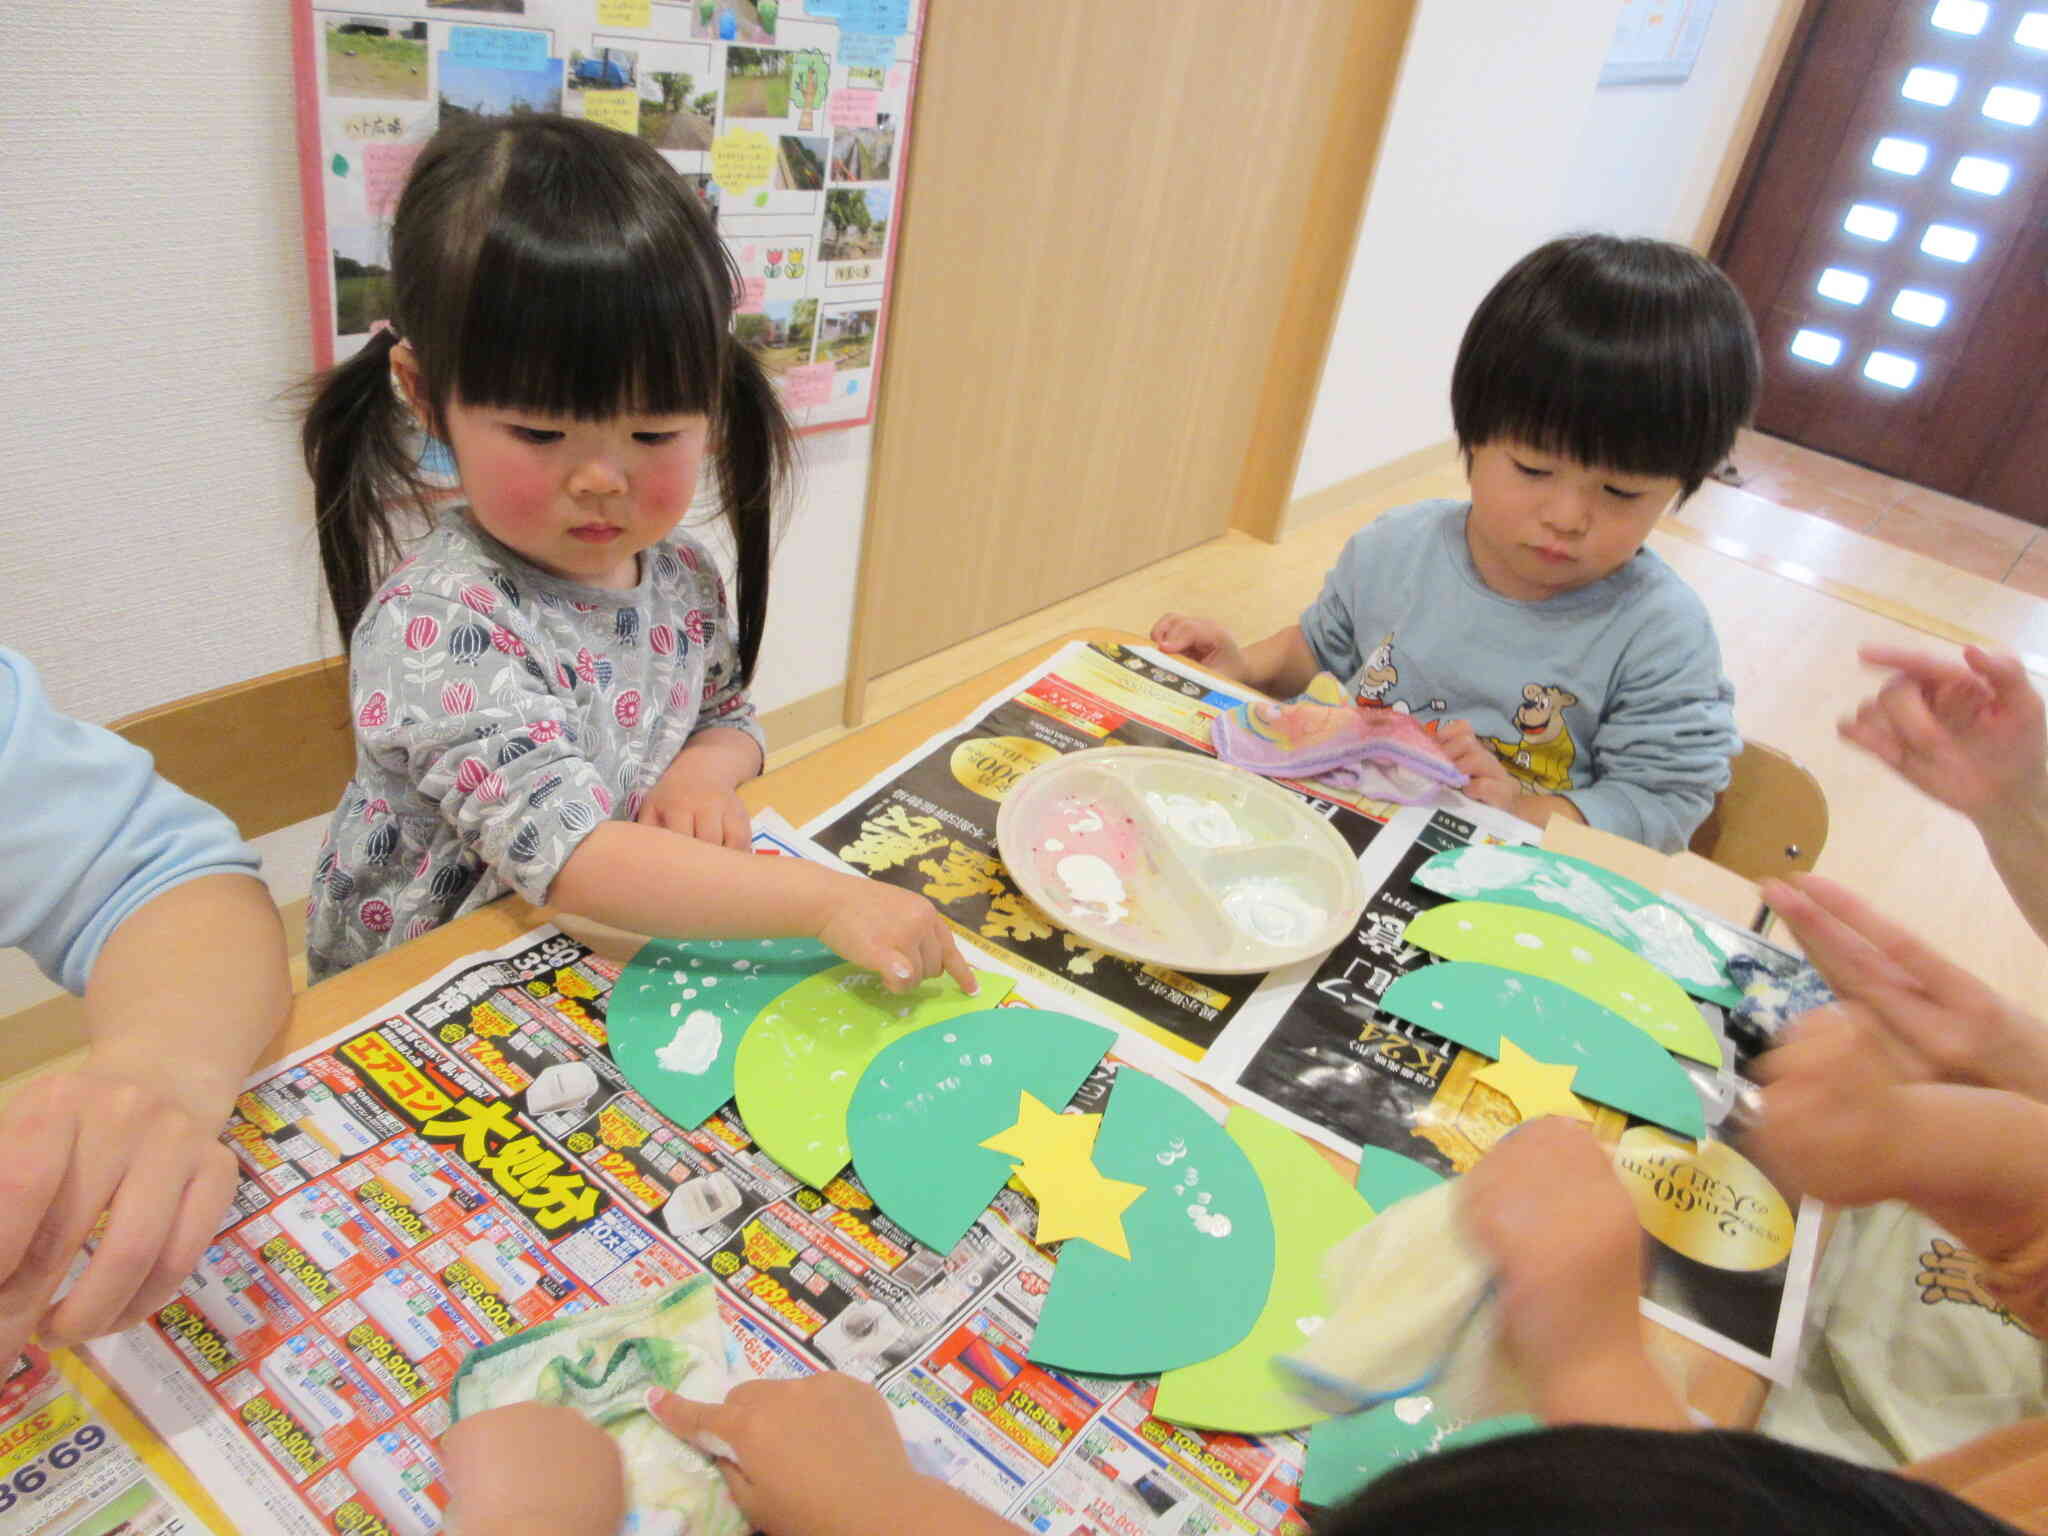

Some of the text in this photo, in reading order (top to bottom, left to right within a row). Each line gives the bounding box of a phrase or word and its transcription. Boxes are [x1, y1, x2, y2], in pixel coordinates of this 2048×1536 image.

[346, 1036, 442, 1112] エアコン
[1359, 1023, 1443, 1079] K24
[422, 1096, 598, 1231] 大処分
